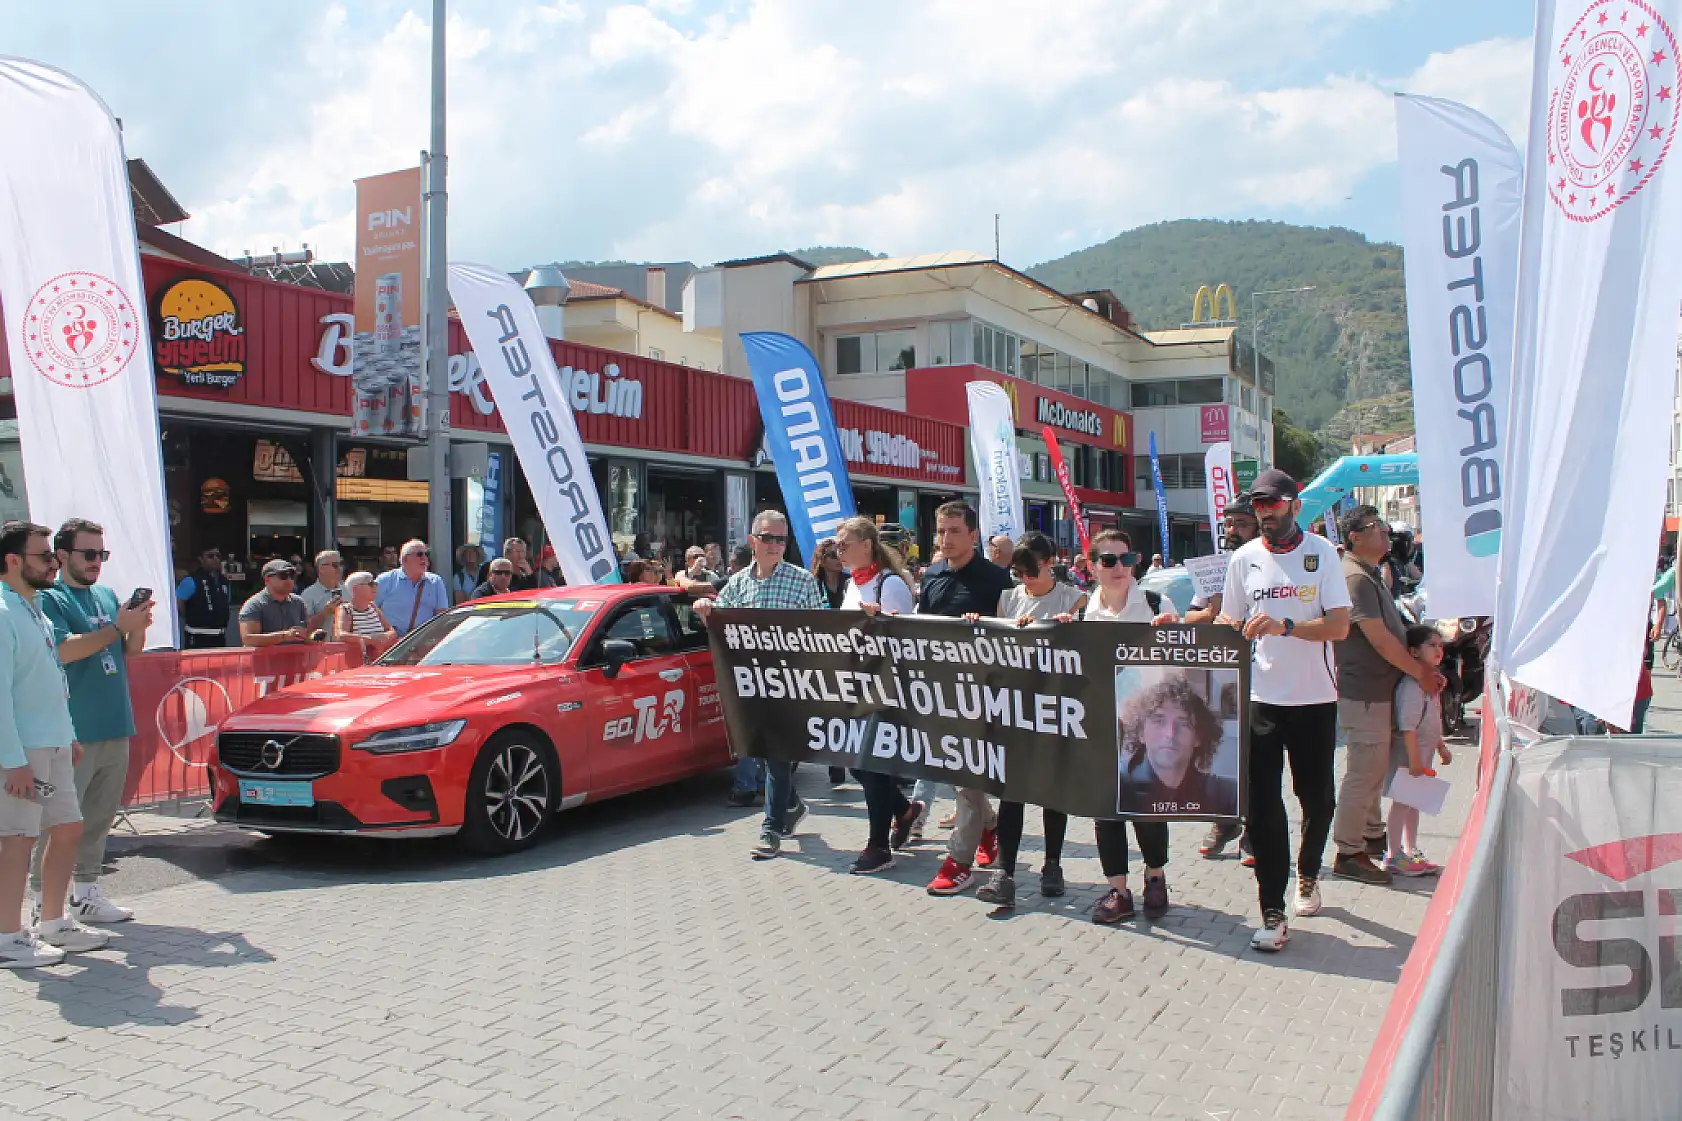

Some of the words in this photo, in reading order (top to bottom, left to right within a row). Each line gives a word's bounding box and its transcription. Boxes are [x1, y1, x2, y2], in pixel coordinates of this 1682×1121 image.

[368, 205, 413, 231] PIN
[1038, 396, 1102, 436] McDonald's
[1253, 584, 1317, 603] CHECK24
[724, 622, 1083, 676] #BisiletimeÇarparsanÖlürüm
[1155, 627, 1197, 645] SENİ
[1115, 643, 1240, 663] ÖZLEYECEĞİZ
[733, 657, 906, 710] BİSİKLETLİ
[910, 670, 1088, 740] ÖLÜMLER
[807, 716, 866, 754] SON
[872, 722, 1006, 783] BULSUN
[1152, 801, 1178, 812] 1978
[1552, 888, 1682, 1017] S
